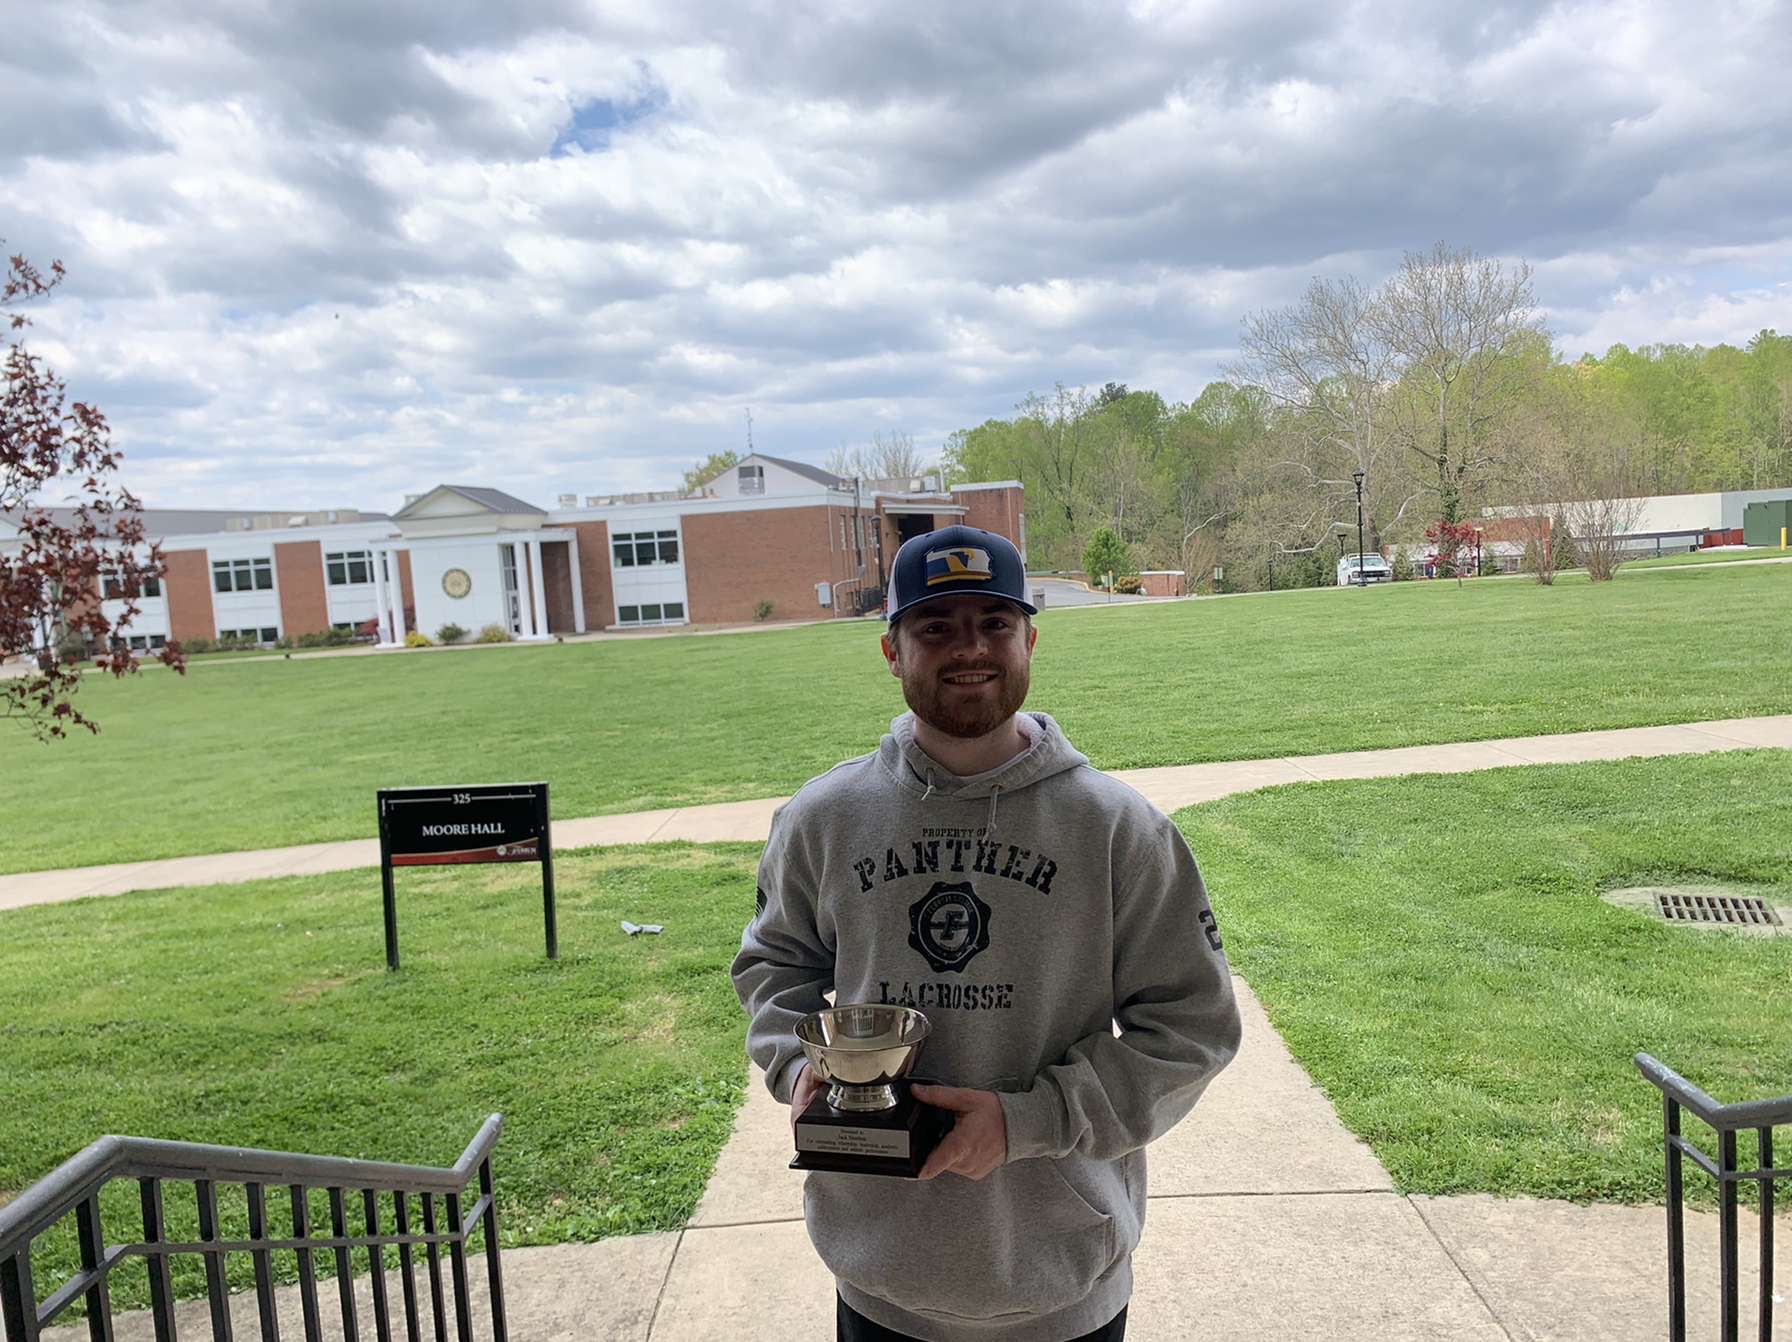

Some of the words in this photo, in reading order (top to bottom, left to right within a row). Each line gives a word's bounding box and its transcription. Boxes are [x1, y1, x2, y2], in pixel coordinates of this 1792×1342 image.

[453, 794, 471, 804] 325
[422, 824, 469, 837] MOORE
[471, 822, 505, 834] HALL
[922, 828, 974, 838] PROPERTY
[854, 839, 1058, 895] PANTHER
[879, 981, 1014, 1010] LACROSSE
